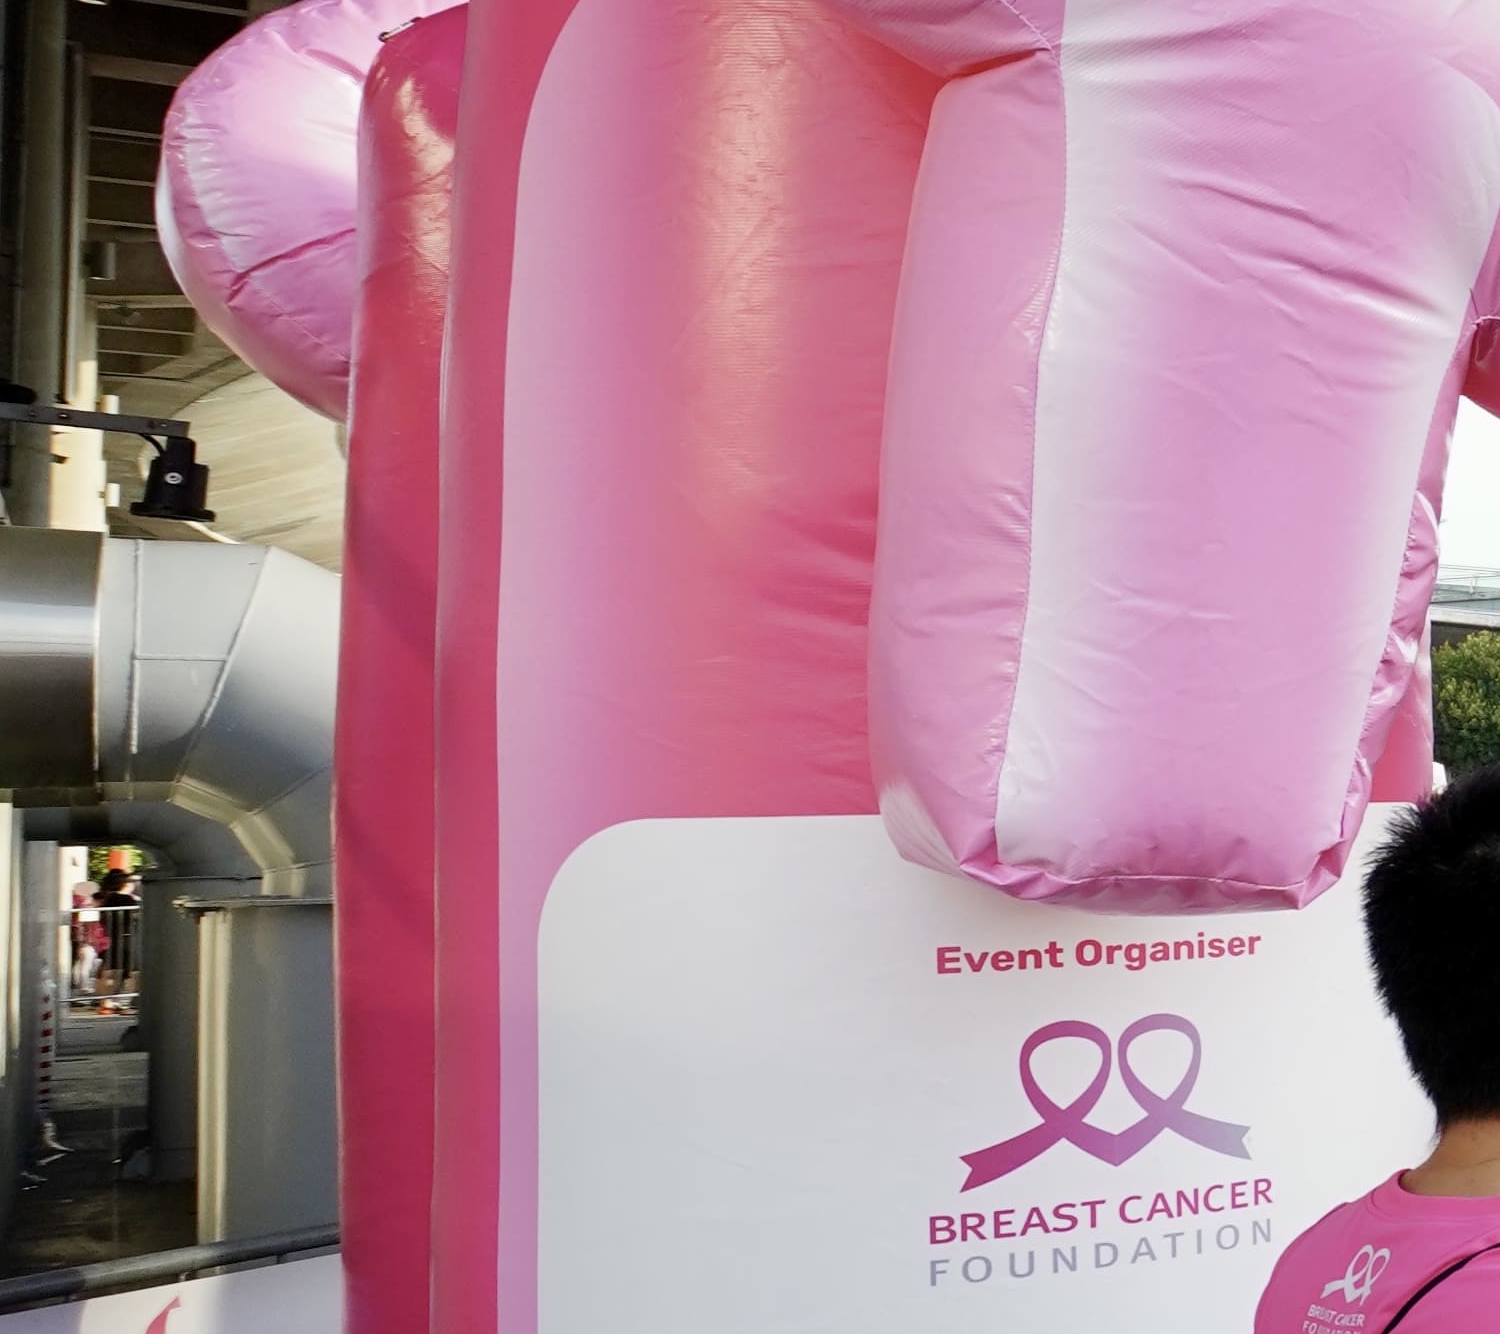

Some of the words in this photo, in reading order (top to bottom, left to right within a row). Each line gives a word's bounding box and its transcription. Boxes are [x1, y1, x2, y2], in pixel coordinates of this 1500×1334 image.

[936, 939, 1064, 974] Event
[1075, 931, 1262, 970] Organiser
[929, 1200, 1106, 1244] BREAST
[1119, 1178, 1273, 1223] CANCER
[929, 1218, 1272, 1286] FOUNDATION
